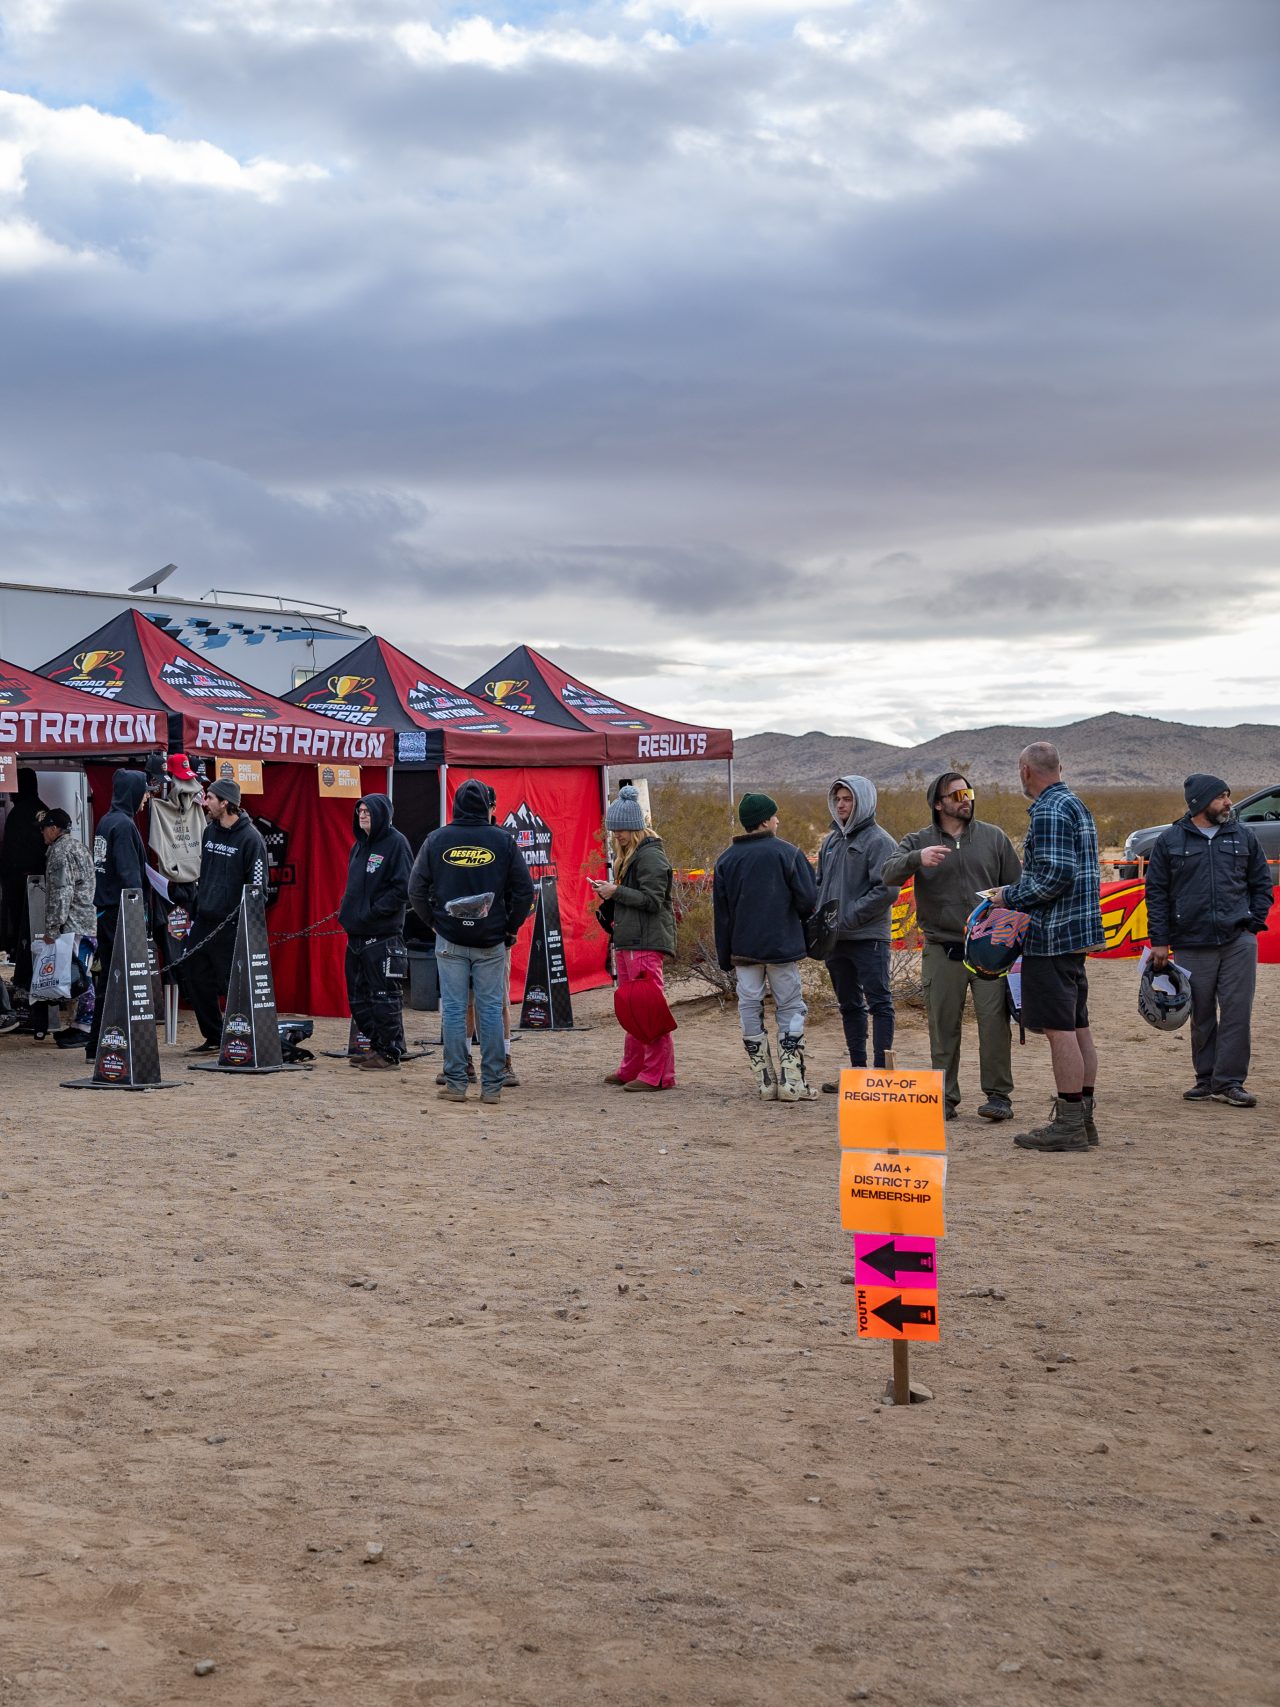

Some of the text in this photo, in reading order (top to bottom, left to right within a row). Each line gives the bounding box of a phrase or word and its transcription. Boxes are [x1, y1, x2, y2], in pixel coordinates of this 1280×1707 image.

[182, 688, 253, 700] NATIONAL
[307, 703, 361, 711] OFFROAD
[428, 708, 486, 720] NATIONAL
[195, 720, 385, 759] REGISTRATION
[638, 733, 708, 758] RESULTS
[238, 764, 252, 773] PRE
[338, 769, 351, 778] PRE
[238, 773, 261, 782] ENTRY
[338, 778, 360, 787] ENTRY
[450, 850, 483, 858] DESERT
[866, 1078, 917, 1089] DAY-OF
[844, 1091, 938, 1104] REGISTRATION
[874, 1162, 902, 1174] AMA
[854, 1174, 929, 1190] DISTRICT 37
[851, 1188, 931, 1204] MEMBERSHIP
[857, 1290, 868, 1333] YOUTH
